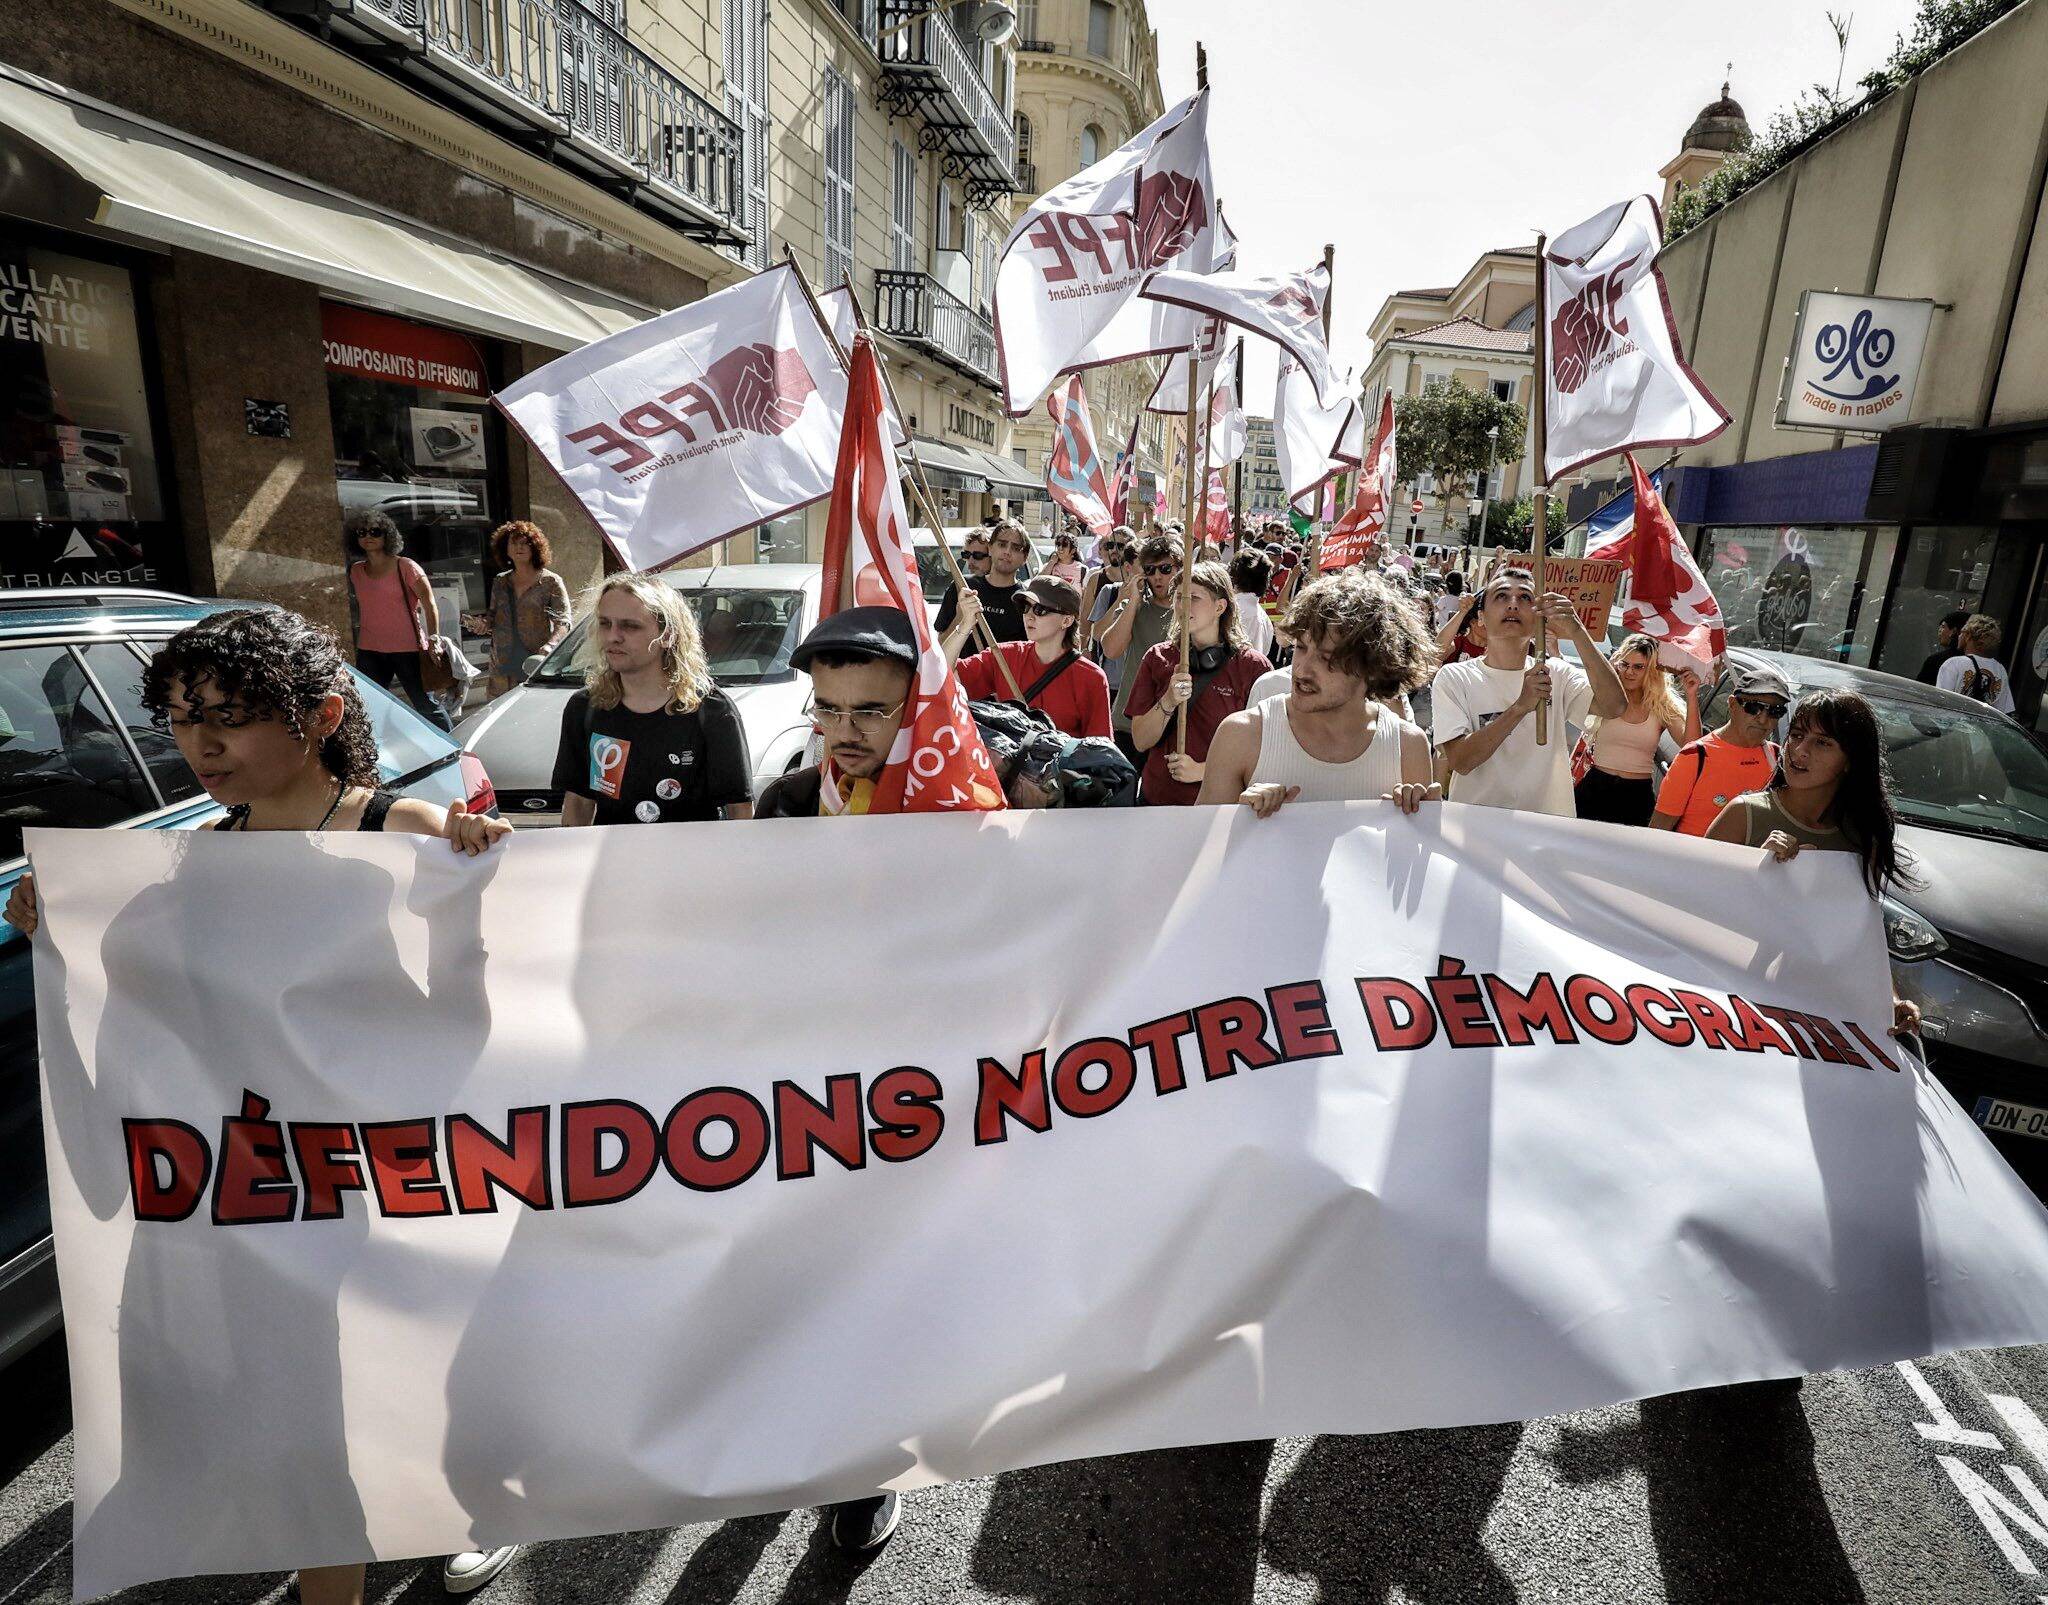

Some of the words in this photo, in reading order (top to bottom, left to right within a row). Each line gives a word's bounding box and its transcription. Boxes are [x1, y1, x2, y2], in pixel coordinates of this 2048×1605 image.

[322, 339, 416, 379] COMPOSANTS
[417, 359, 479, 390] DIFFUSION
[1802, 390, 1837, 413] made
[1840, 403, 1852, 416] in
[1856, 390, 1903, 416] naples
[2, 568, 158, 589] TRIANGLE
[1580, 589, 1601, 603] est
[121, 1065, 945, 1226] DÉFENDONS
[973, 978, 1343, 1146] NOTRE
[1354, 955, 1875, 1070] DÉMOCRATIE
[1841, 1020, 1901, 1073] !
